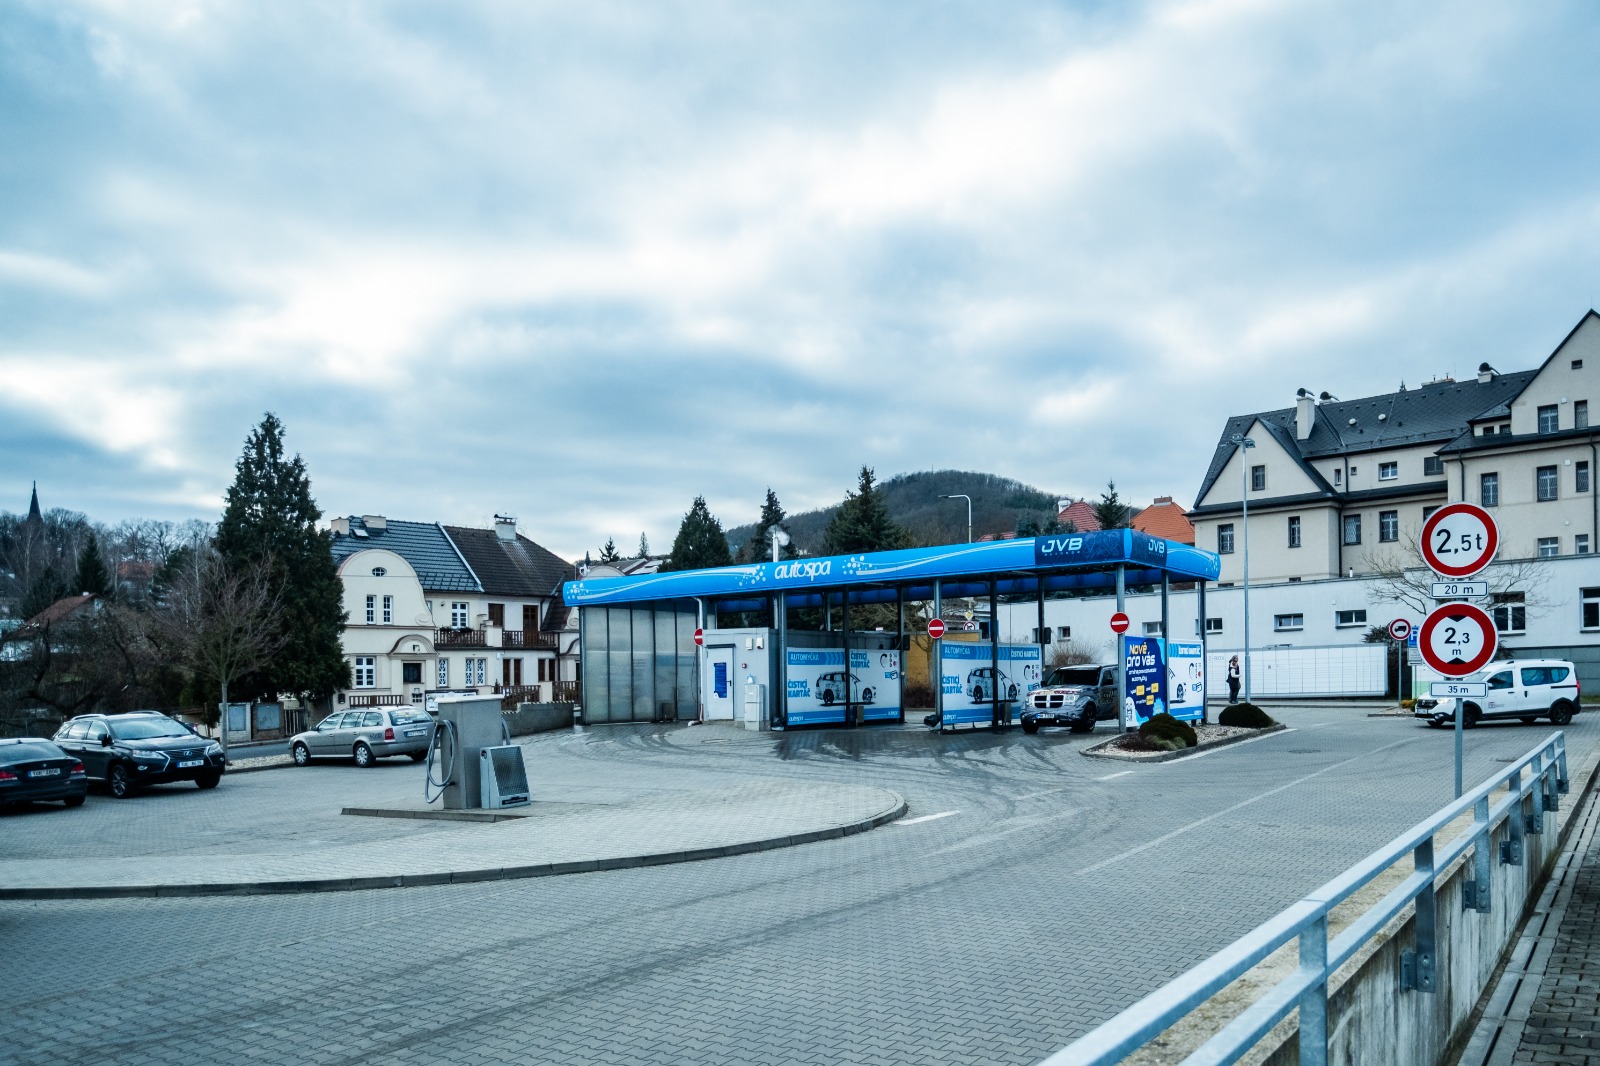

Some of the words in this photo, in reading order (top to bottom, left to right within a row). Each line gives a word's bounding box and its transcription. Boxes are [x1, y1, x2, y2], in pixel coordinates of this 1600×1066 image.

[1041, 537, 1083, 553] JVB
[1148, 538, 1165, 554] JVB
[774, 560, 832, 582] autospa
[1444, 584, 1458, 595] 20
[1463, 586, 1474, 594] m
[1444, 627, 1470, 646] 2,3
[1126, 655, 1140, 671] pro
[1141, 651, 1156, 666] vás
[1447, 685, 1458, 694] 35
